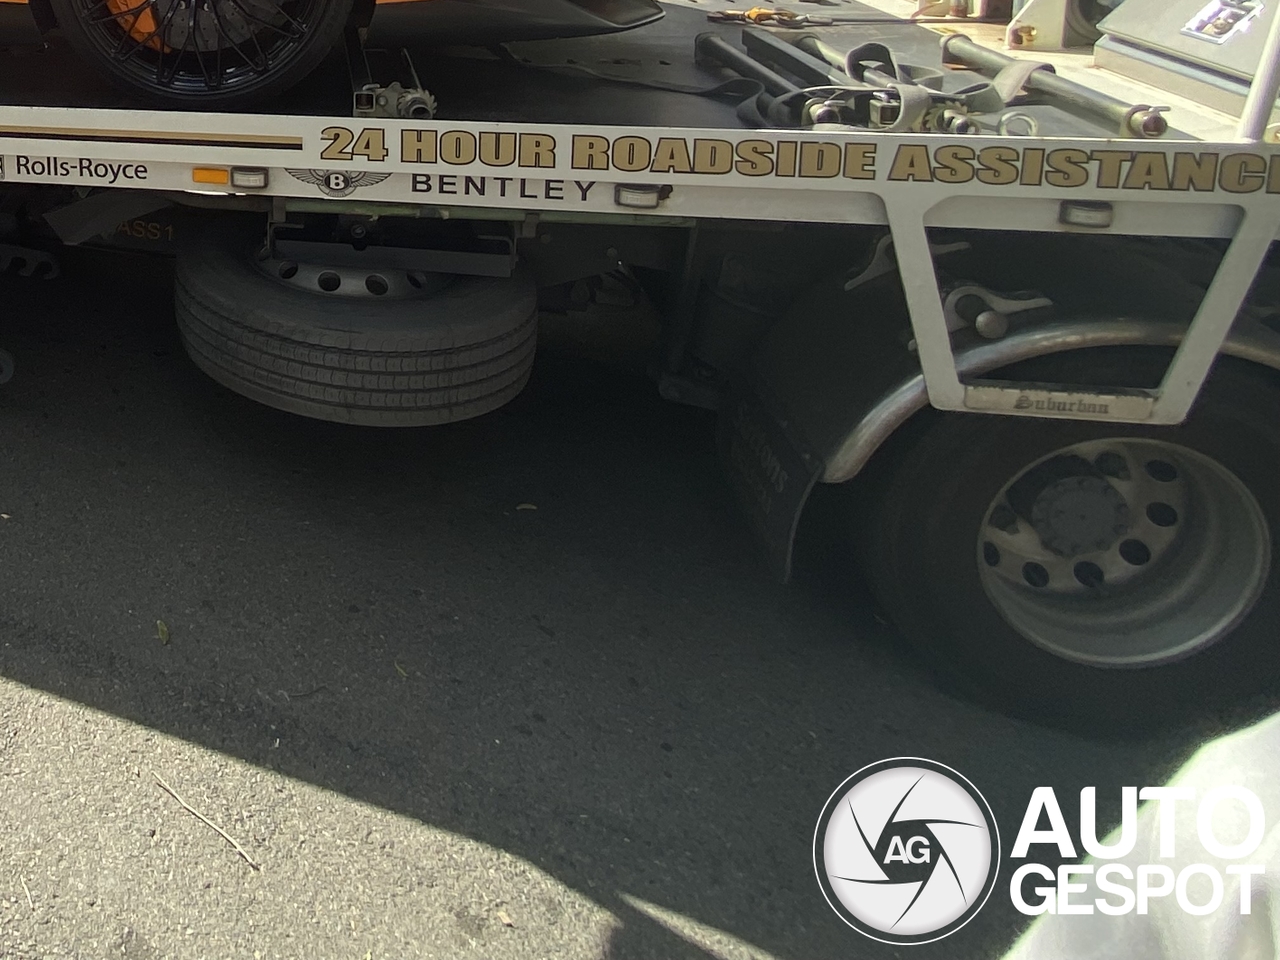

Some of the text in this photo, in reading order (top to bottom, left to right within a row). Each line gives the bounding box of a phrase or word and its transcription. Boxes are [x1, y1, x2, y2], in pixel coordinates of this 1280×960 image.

[320, 126, 389, 161] 24
[401, 129, 556, 168] HOUR
[571, 134, 877, 180] ROADSIDE
[16, 155, 148, 184] Rolls-Royce
[412, 173, 597, 201] BENTLEY
[1013, 395, 1109, 414] Suburban
